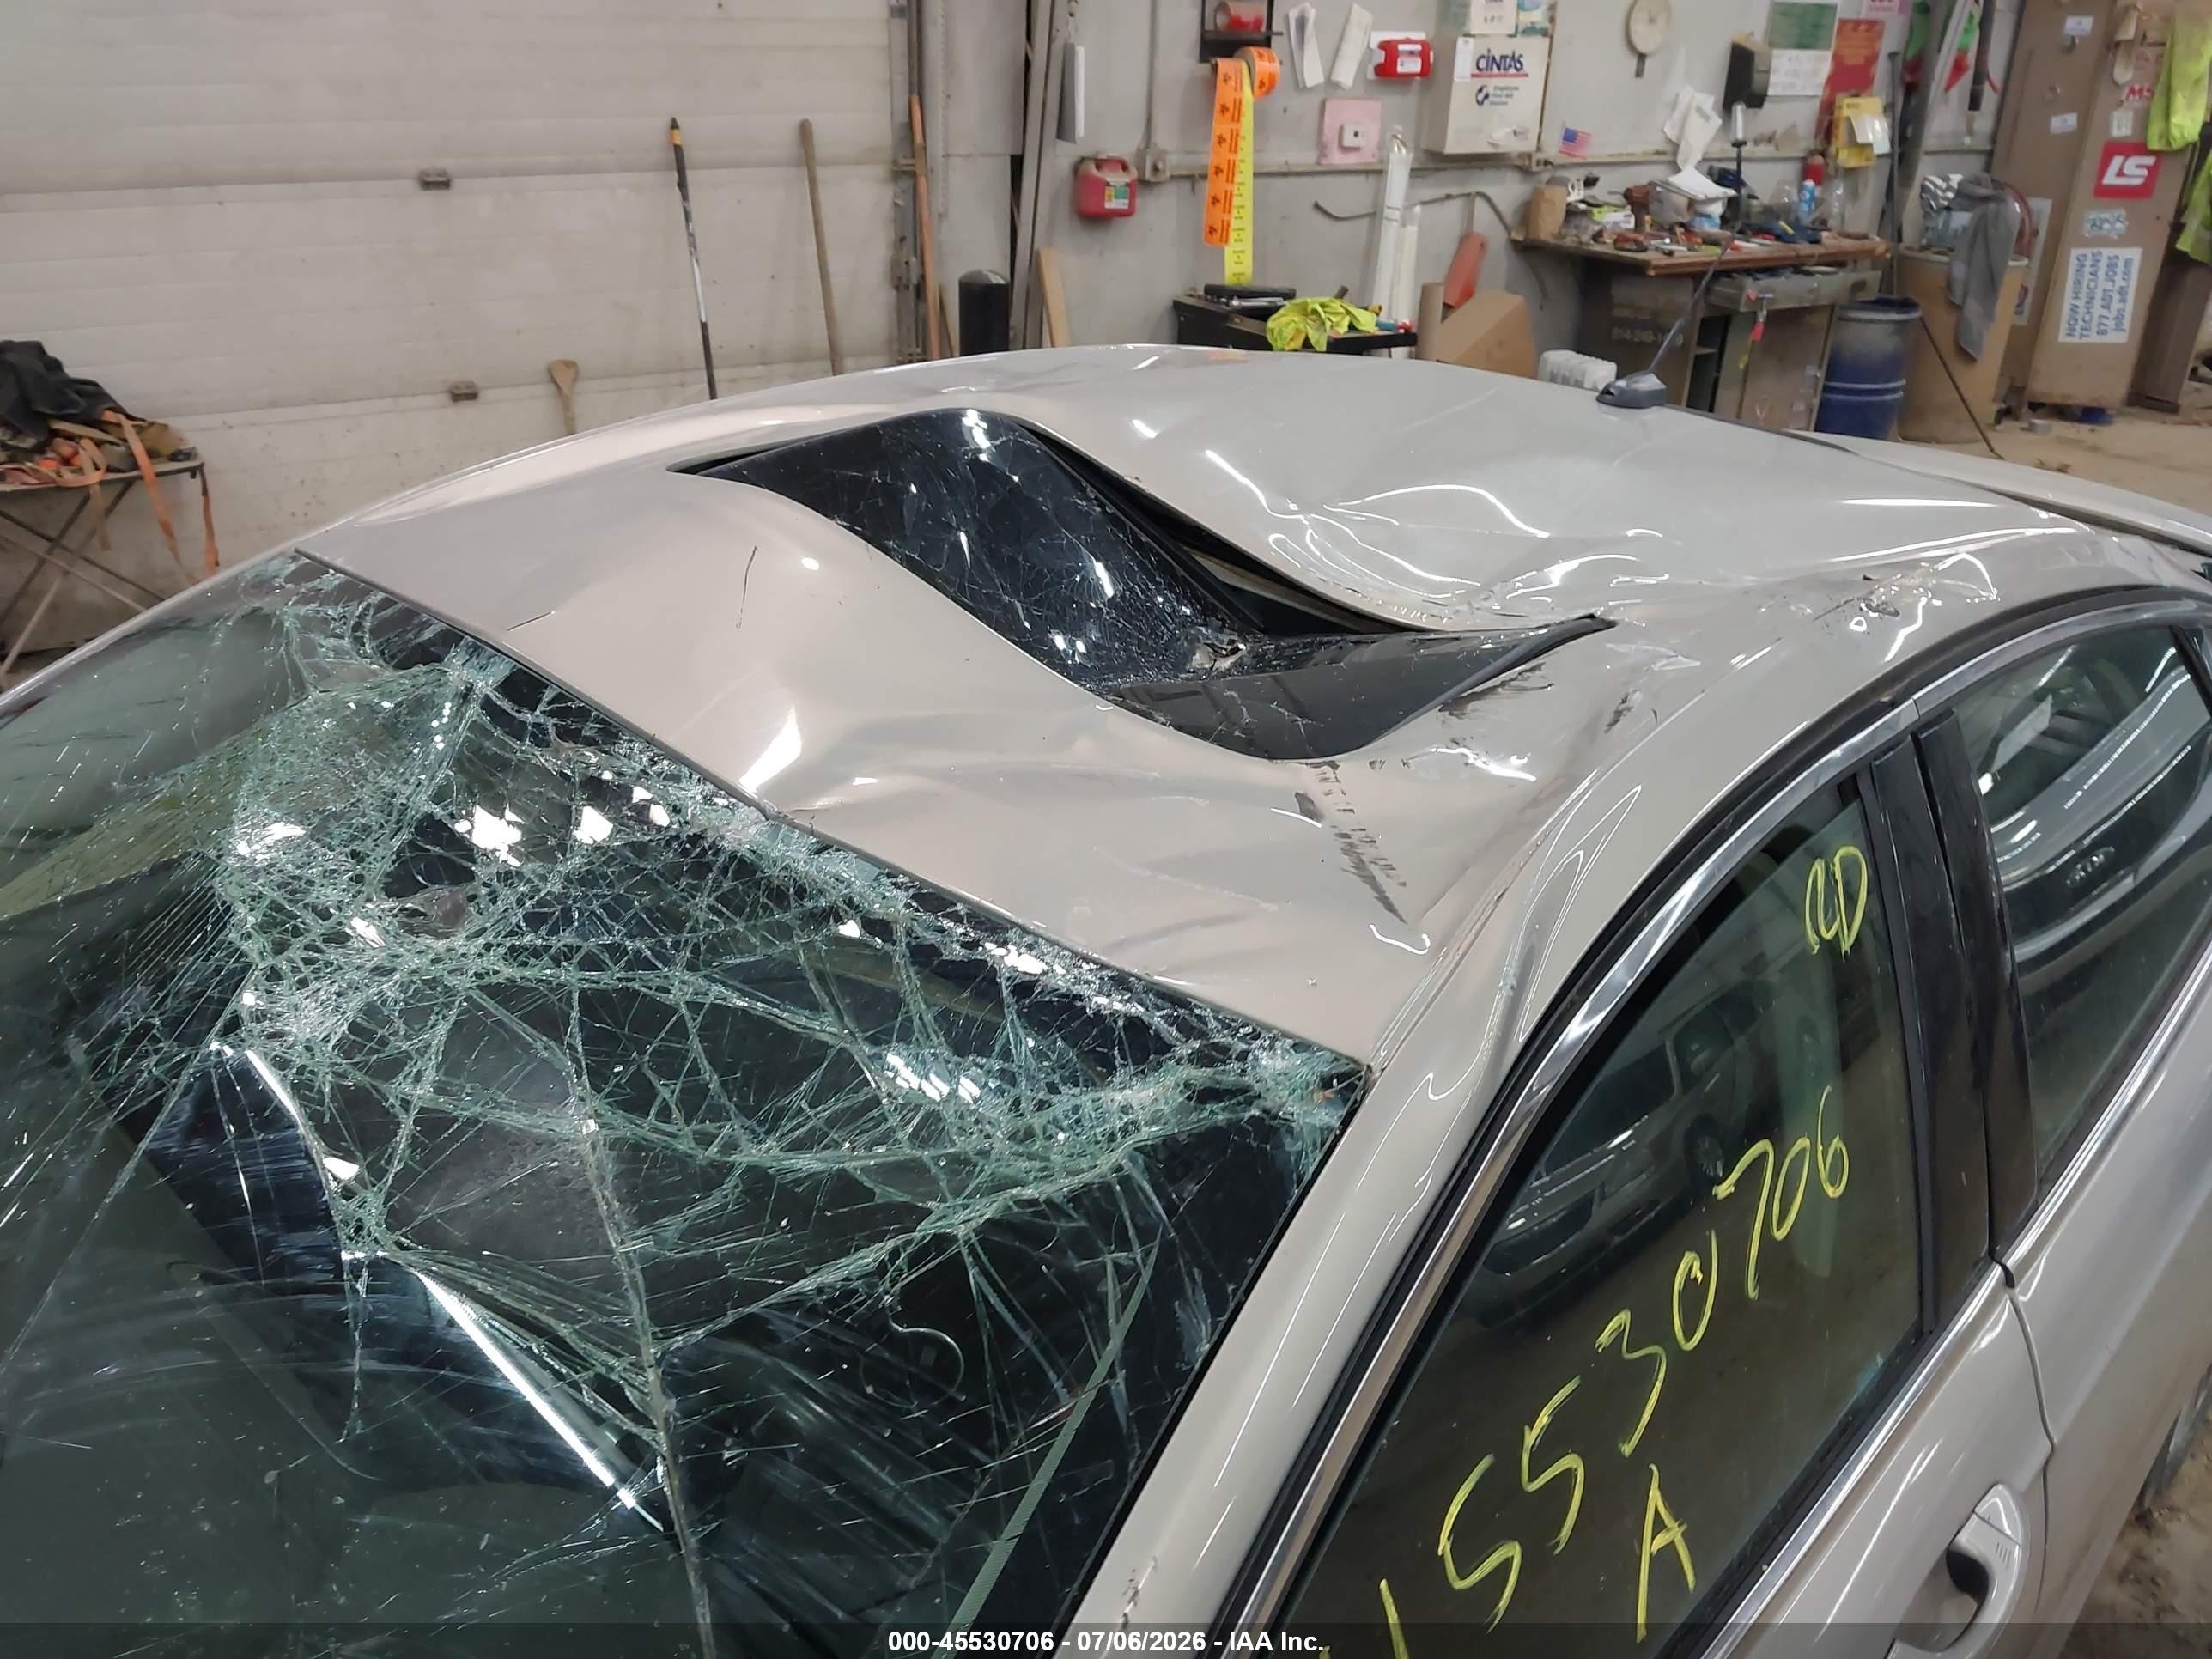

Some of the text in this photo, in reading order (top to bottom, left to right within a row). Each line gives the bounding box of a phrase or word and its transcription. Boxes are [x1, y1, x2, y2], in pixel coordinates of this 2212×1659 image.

[1475, 48, 1523, 71] CINTAS
[2066, 253, 2087, 337] NOW HIRING
[2079, 251, 2103, 340] TECHNICIANS
[2096, 314, 2110, 336] 877
[2105, 254, 2120, 288] JOBS
[1635, 1463, 1697, 1642] A
